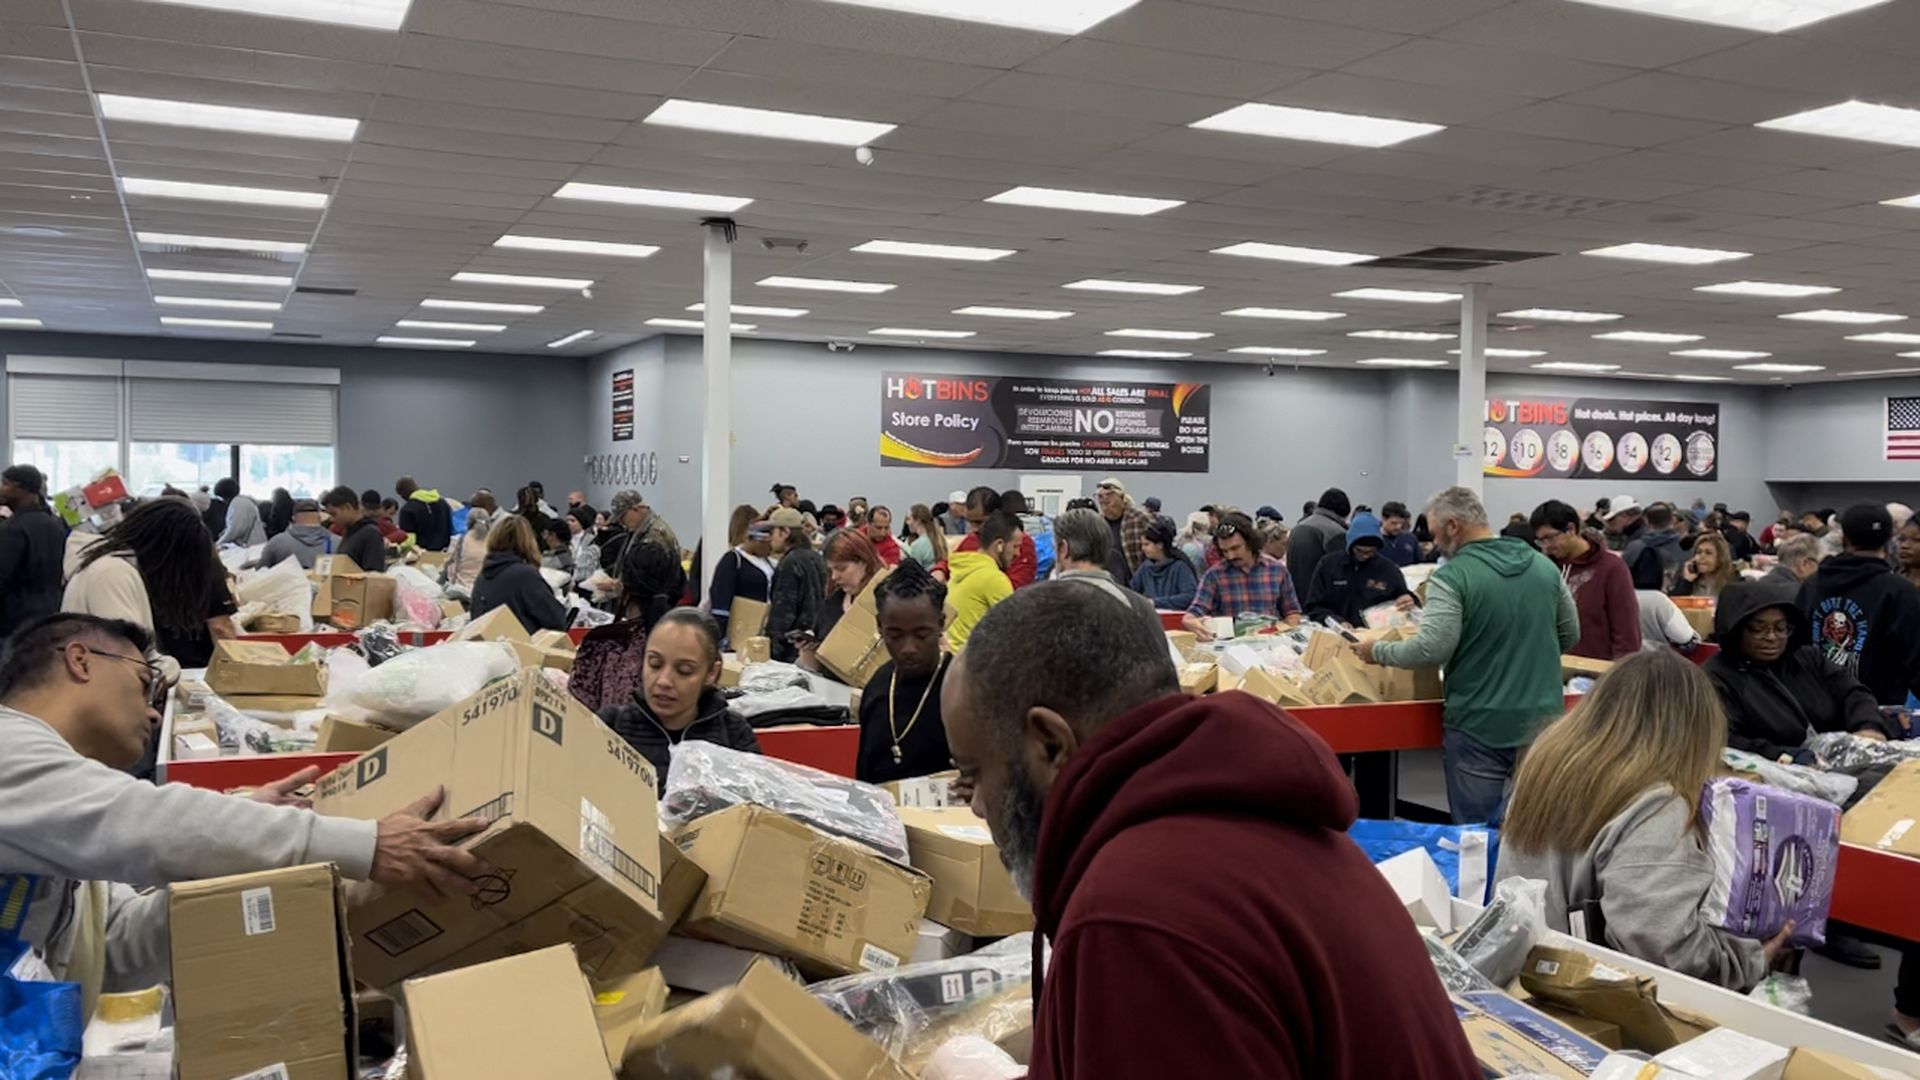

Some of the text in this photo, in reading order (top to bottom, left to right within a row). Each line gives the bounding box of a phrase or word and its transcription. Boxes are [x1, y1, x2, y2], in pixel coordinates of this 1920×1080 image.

[887, 376, 989, 401] HOTBINS
[1091, 387, 1105, 396] ALL
[1106, 387, 1130, 396] SALES
[1131, 388, 1146, 398] ARE
[1484, 398, 1568, 425] OTBINS
[1574, 408, 1590, 419] Hot
[1618, 409, 1634, 421] Hot
[1664, 411, 1675, 422] All
[1676, 412, 1694, 425] day
[1694, 413, 1716, 426] long!
[891, 411, 980, 431] Store Policy
[1075, 409, 1114, 433] NO
[1180, 416, 1206, 424] PLEASE
[1179, 425, 1207, 435] DO NOT
[1175, 435, 1208, 445] OPEN THE
[1024, 447, 1039, 455] SON
[1067, 448, 1084, 456] TODO
[1180, 446, 1205, 454] BOXES
[1483, 441, 1498, 457] 12
[1513, 441, 1536, 458] $10
[1554, 442, 1568, 459] $8
[1624, 443, 1637, 459] $4
[1659, 444, 1672, 461] $2
[1040, 455, 1070, 463] GRACIAS
[1070, 456, 1084, 464] POR
[1127, 458, 1149, 466] CAJAS
